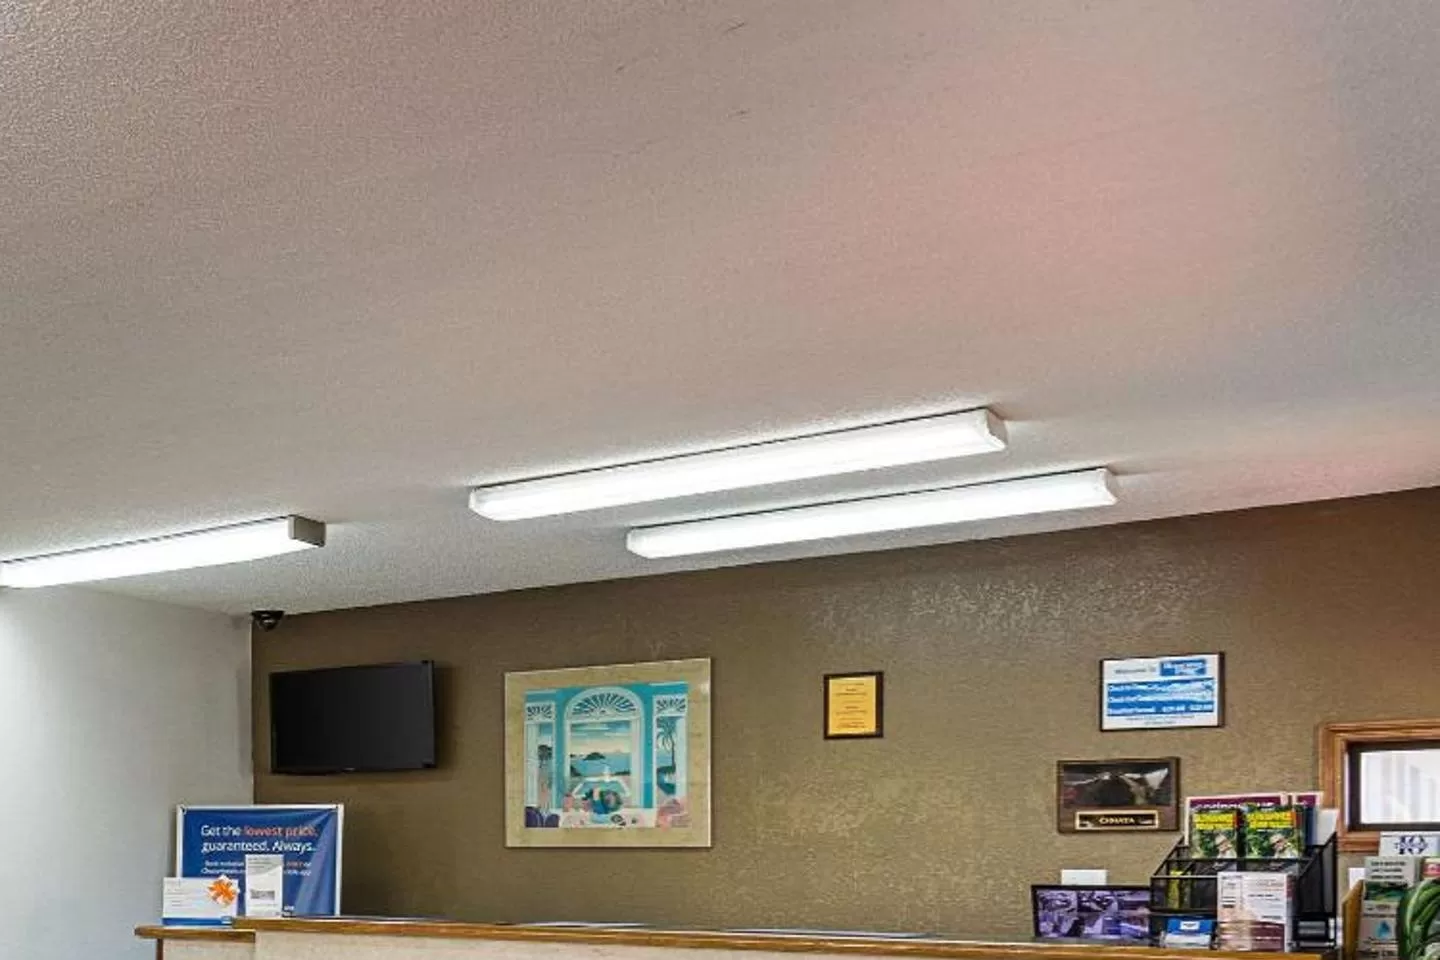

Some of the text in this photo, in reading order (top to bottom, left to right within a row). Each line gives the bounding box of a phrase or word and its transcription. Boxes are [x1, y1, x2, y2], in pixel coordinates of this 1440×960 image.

[201, 825, 220, 836] Get
[221, 825, 241, 836] the
[243, 825, 281, 837] lowest
